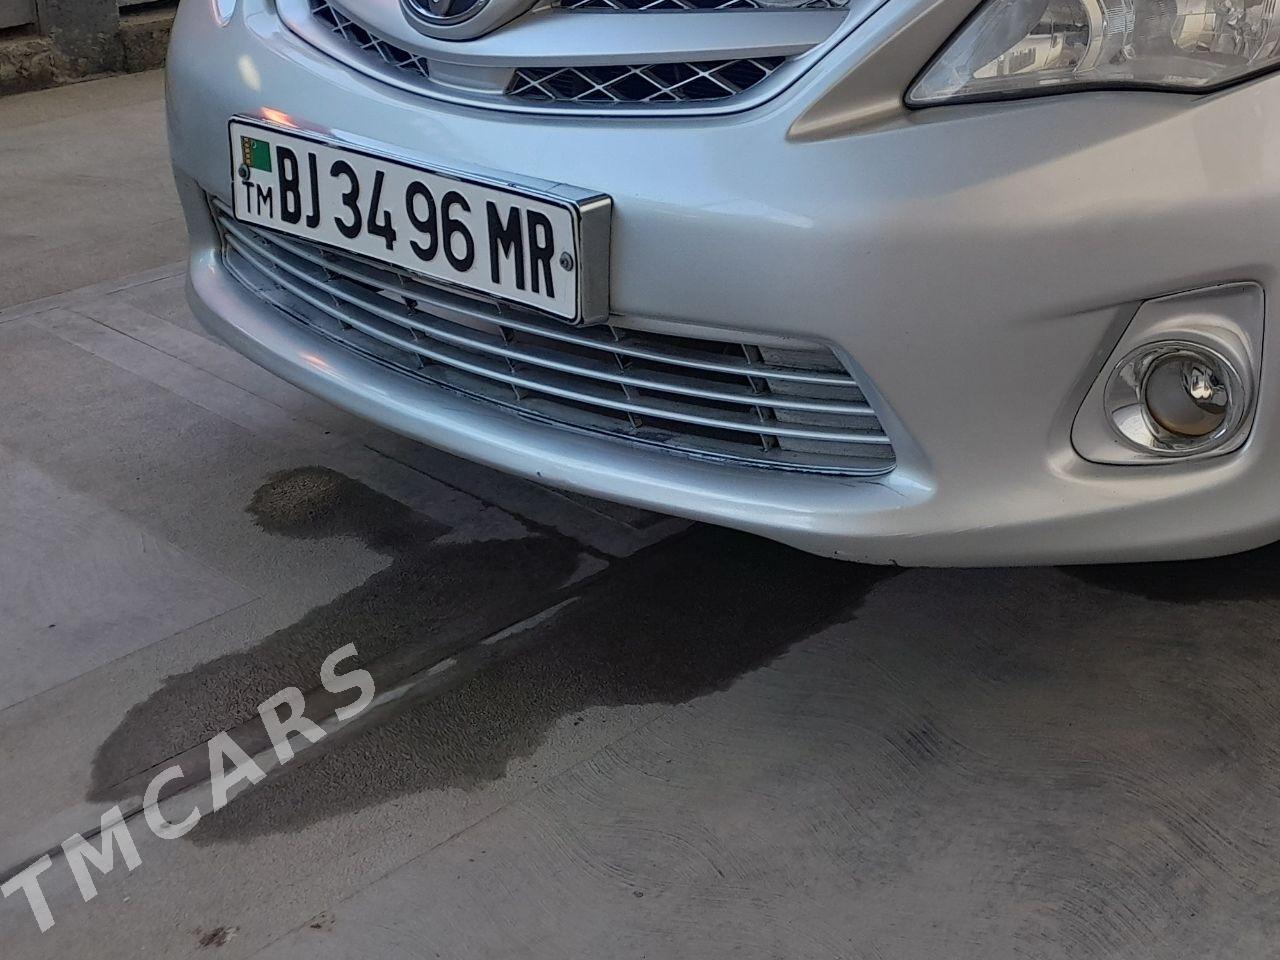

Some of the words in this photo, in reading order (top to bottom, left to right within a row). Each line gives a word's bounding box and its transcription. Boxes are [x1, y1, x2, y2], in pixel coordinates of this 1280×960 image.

[242, 180, 274, 219] TM
[275, 145, 321, 229] BJ
[329, 159, 475, 272] 3496
[485, 200, 556, 299] MR
